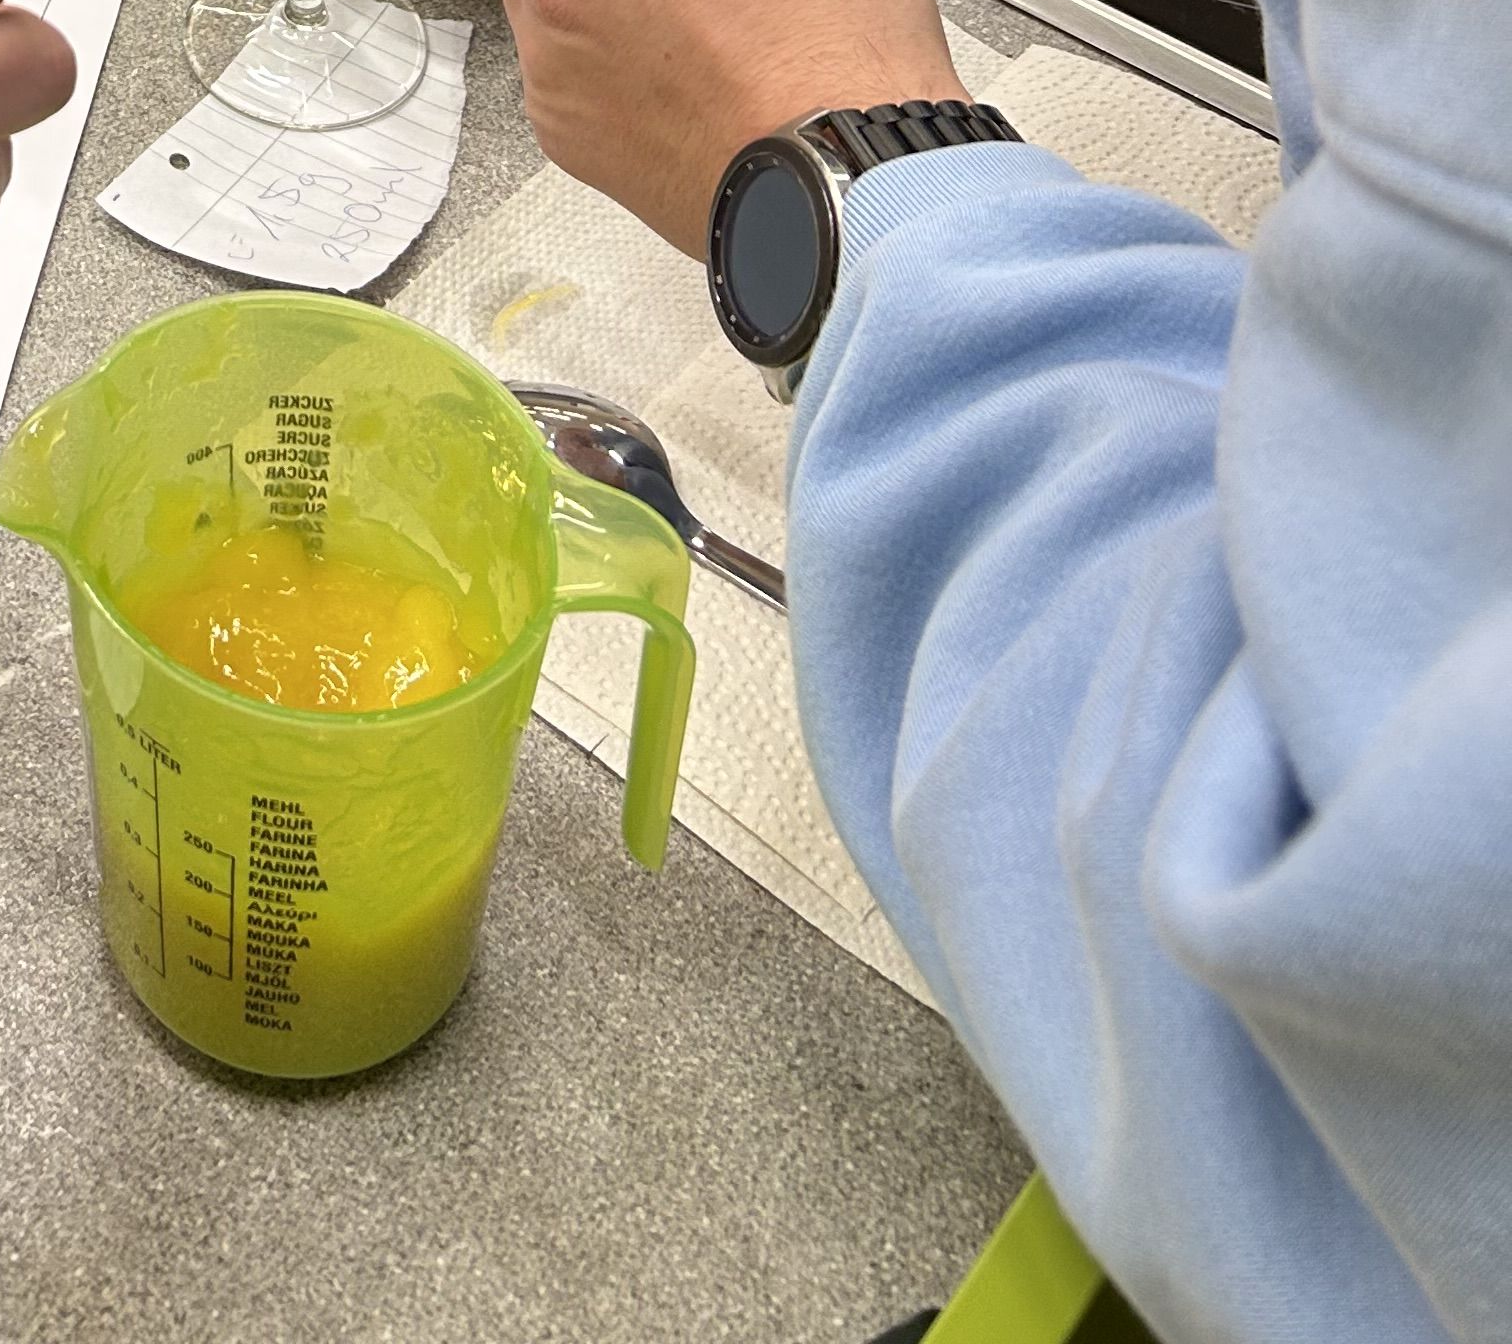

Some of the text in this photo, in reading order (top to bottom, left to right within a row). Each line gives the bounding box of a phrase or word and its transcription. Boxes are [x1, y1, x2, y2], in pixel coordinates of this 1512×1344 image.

[140, 735, 182, 775] LITER
[251, 794, 305, 816] MEHL
[251, 811, 313, 831] FLOUR
[184, 829, 213, 854] 250
[250, 826, 317, 846] FARINE
[250, 841, 317, 861] FARINA
[249, 856, 319, 877] HARINA
[185, 869, 213, 893] 200
[249, 870, 328, 891] FARINHA
[248, 886, 296, 906] MEEL
[187, 915, 213, 937] 150
[247, 929, 310, 949] MOUKA
[188, 955, 213, 977] 100
[246, 957, 292, 976] LISZT
[245, 986, 300, 1005] JAUHO
[245, 1000, 276, 1016] MEL
